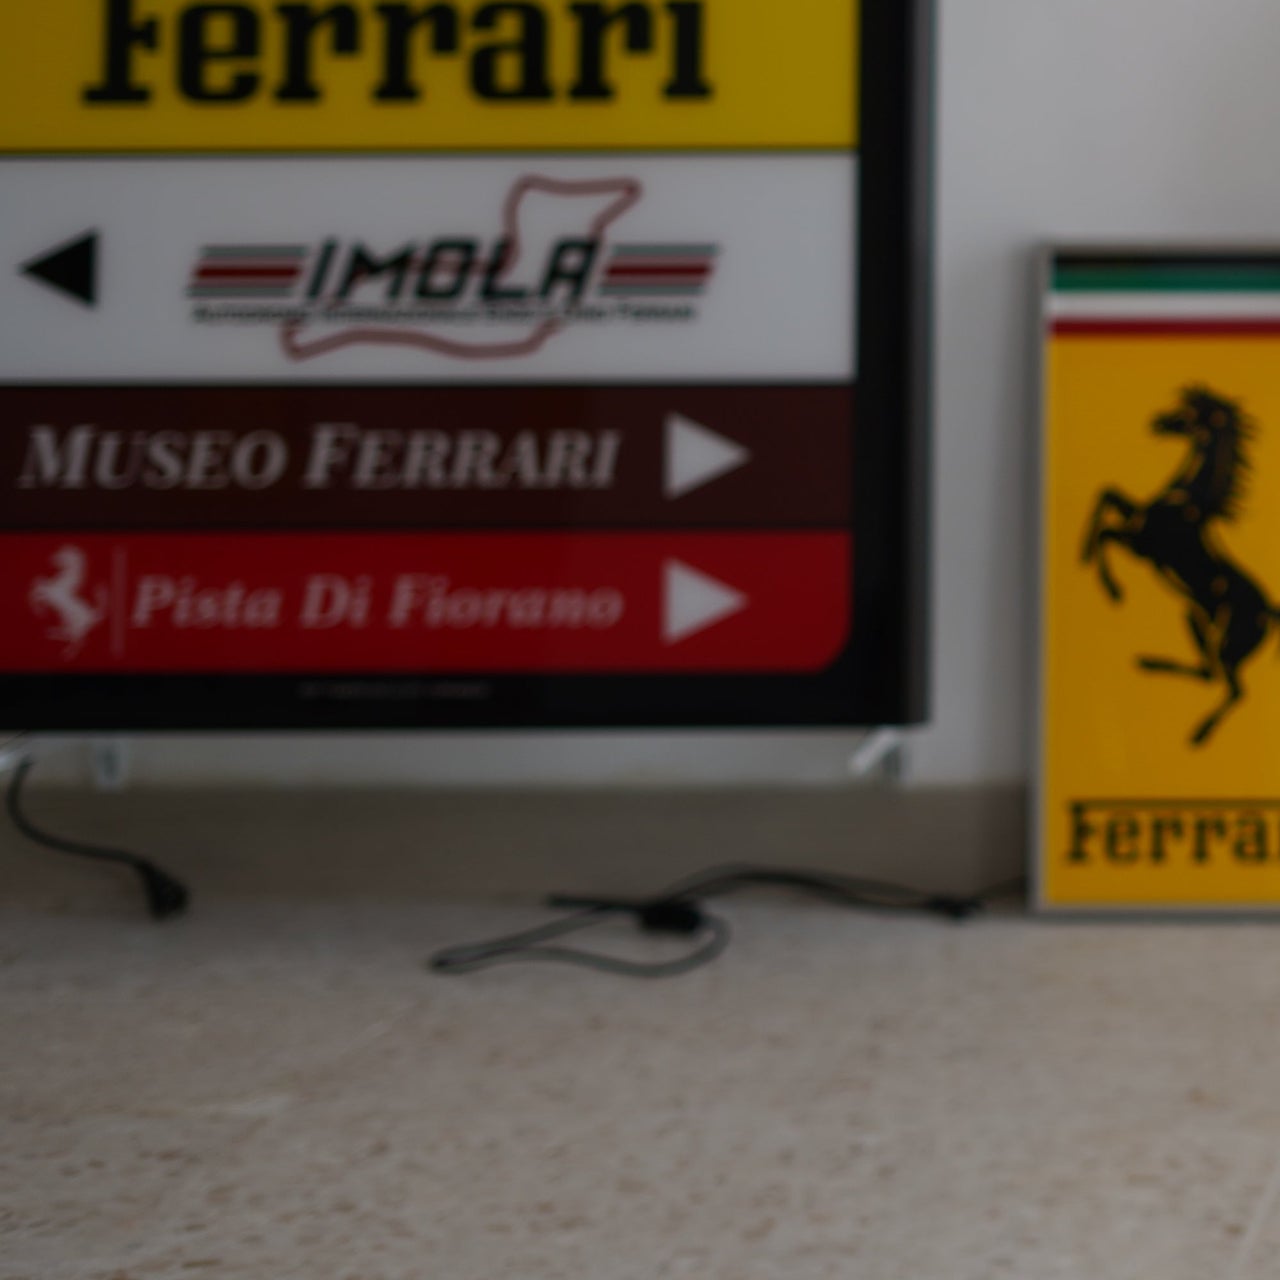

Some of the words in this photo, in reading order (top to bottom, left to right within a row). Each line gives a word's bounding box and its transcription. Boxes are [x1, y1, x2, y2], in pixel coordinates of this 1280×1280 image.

[306, 236, 600, 302] IMOLA
[18, 423, 289, 490] MUSEO
[302, 422, 622, 490] FERRARI
[132, 573, 284, 630] Pista
[299, 572, 374, 631] Di
[389, 572, 625, 631] Fiorano
